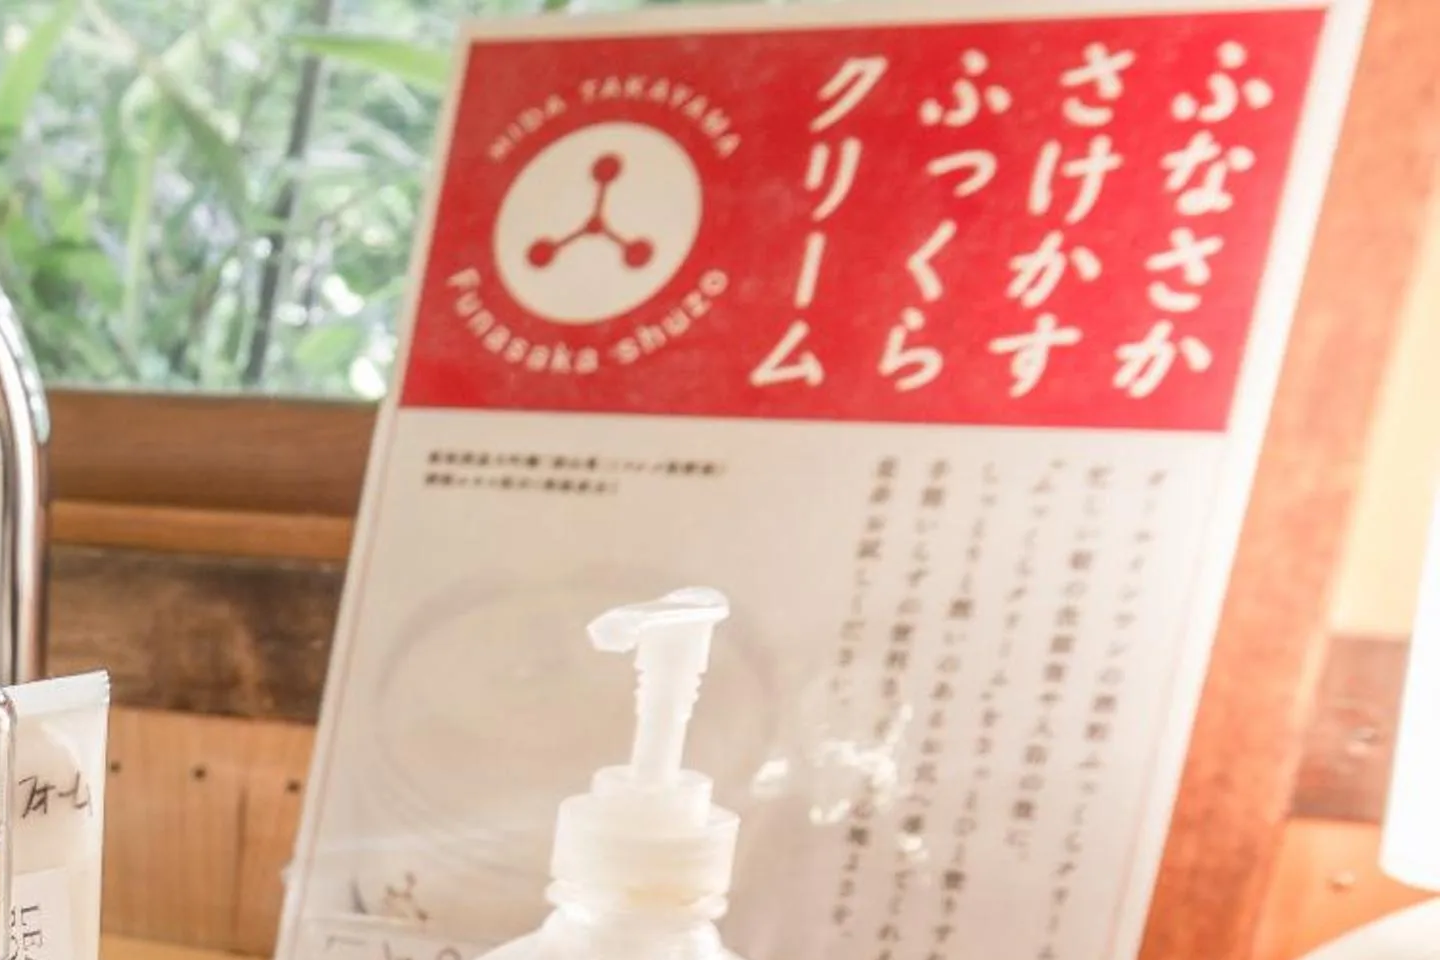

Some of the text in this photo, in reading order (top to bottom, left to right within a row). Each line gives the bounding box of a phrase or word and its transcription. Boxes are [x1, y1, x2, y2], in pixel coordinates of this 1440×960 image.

[488, 77, 742, 162] HIDA TAKAYAMA
[749, 56, 887, 388] クリーム
[879, 48, 1011, 391] ふっくら
[990, 41, 1135, 398] さけかす
[1112, 41, 1273, 397] ふなさか
[447, 266, 730, 375] Funasaka shuzo
